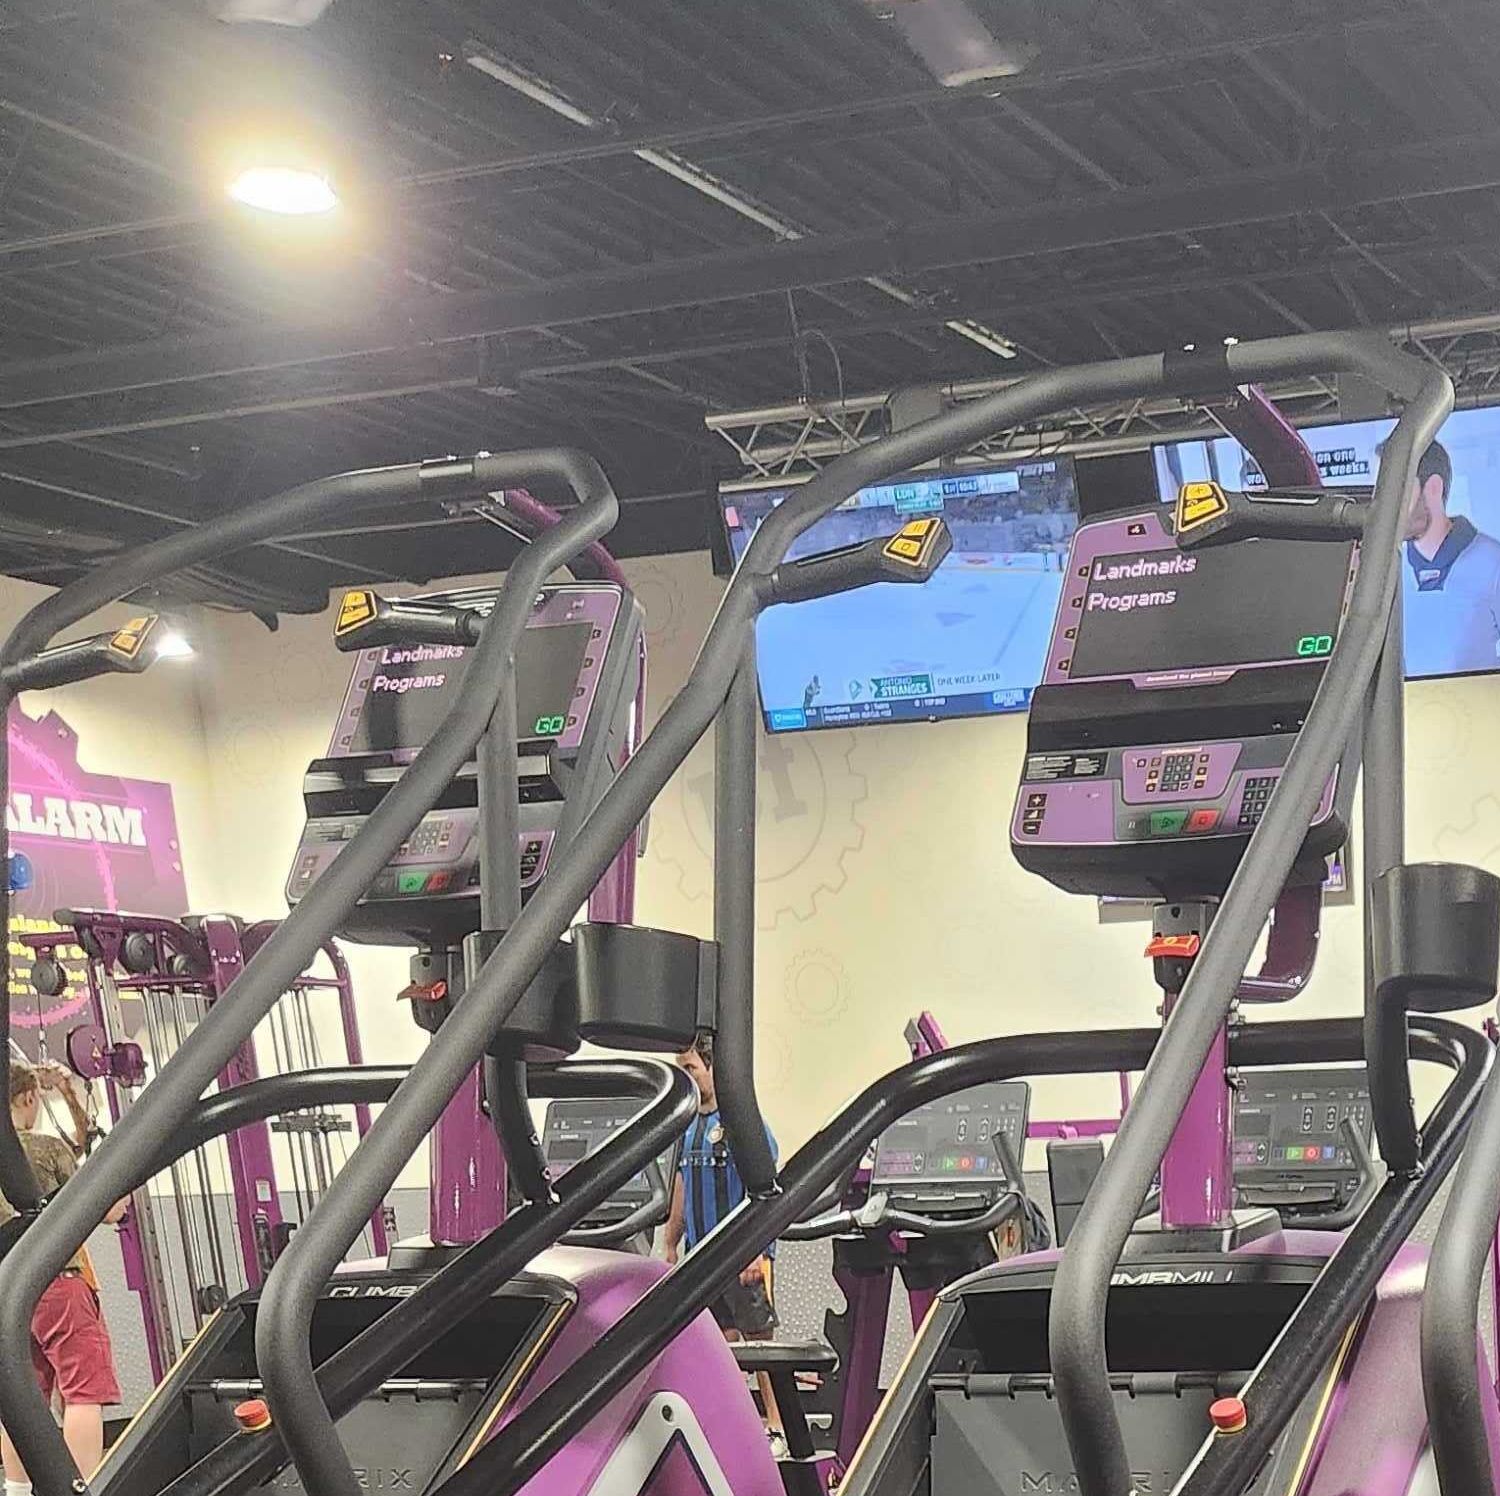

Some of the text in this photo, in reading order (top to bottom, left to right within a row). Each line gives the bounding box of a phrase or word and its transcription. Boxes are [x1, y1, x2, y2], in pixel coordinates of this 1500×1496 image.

[1093, 553, 1198, 581] Landmarks
[1087, 588, 1177, 612] Programs
[381, 643, 464, 665] Landmarks
[1297, 634, 1333, 655] GO
[373, 672, 446, 694] Programs
[535, 714, 565, 735] GO
